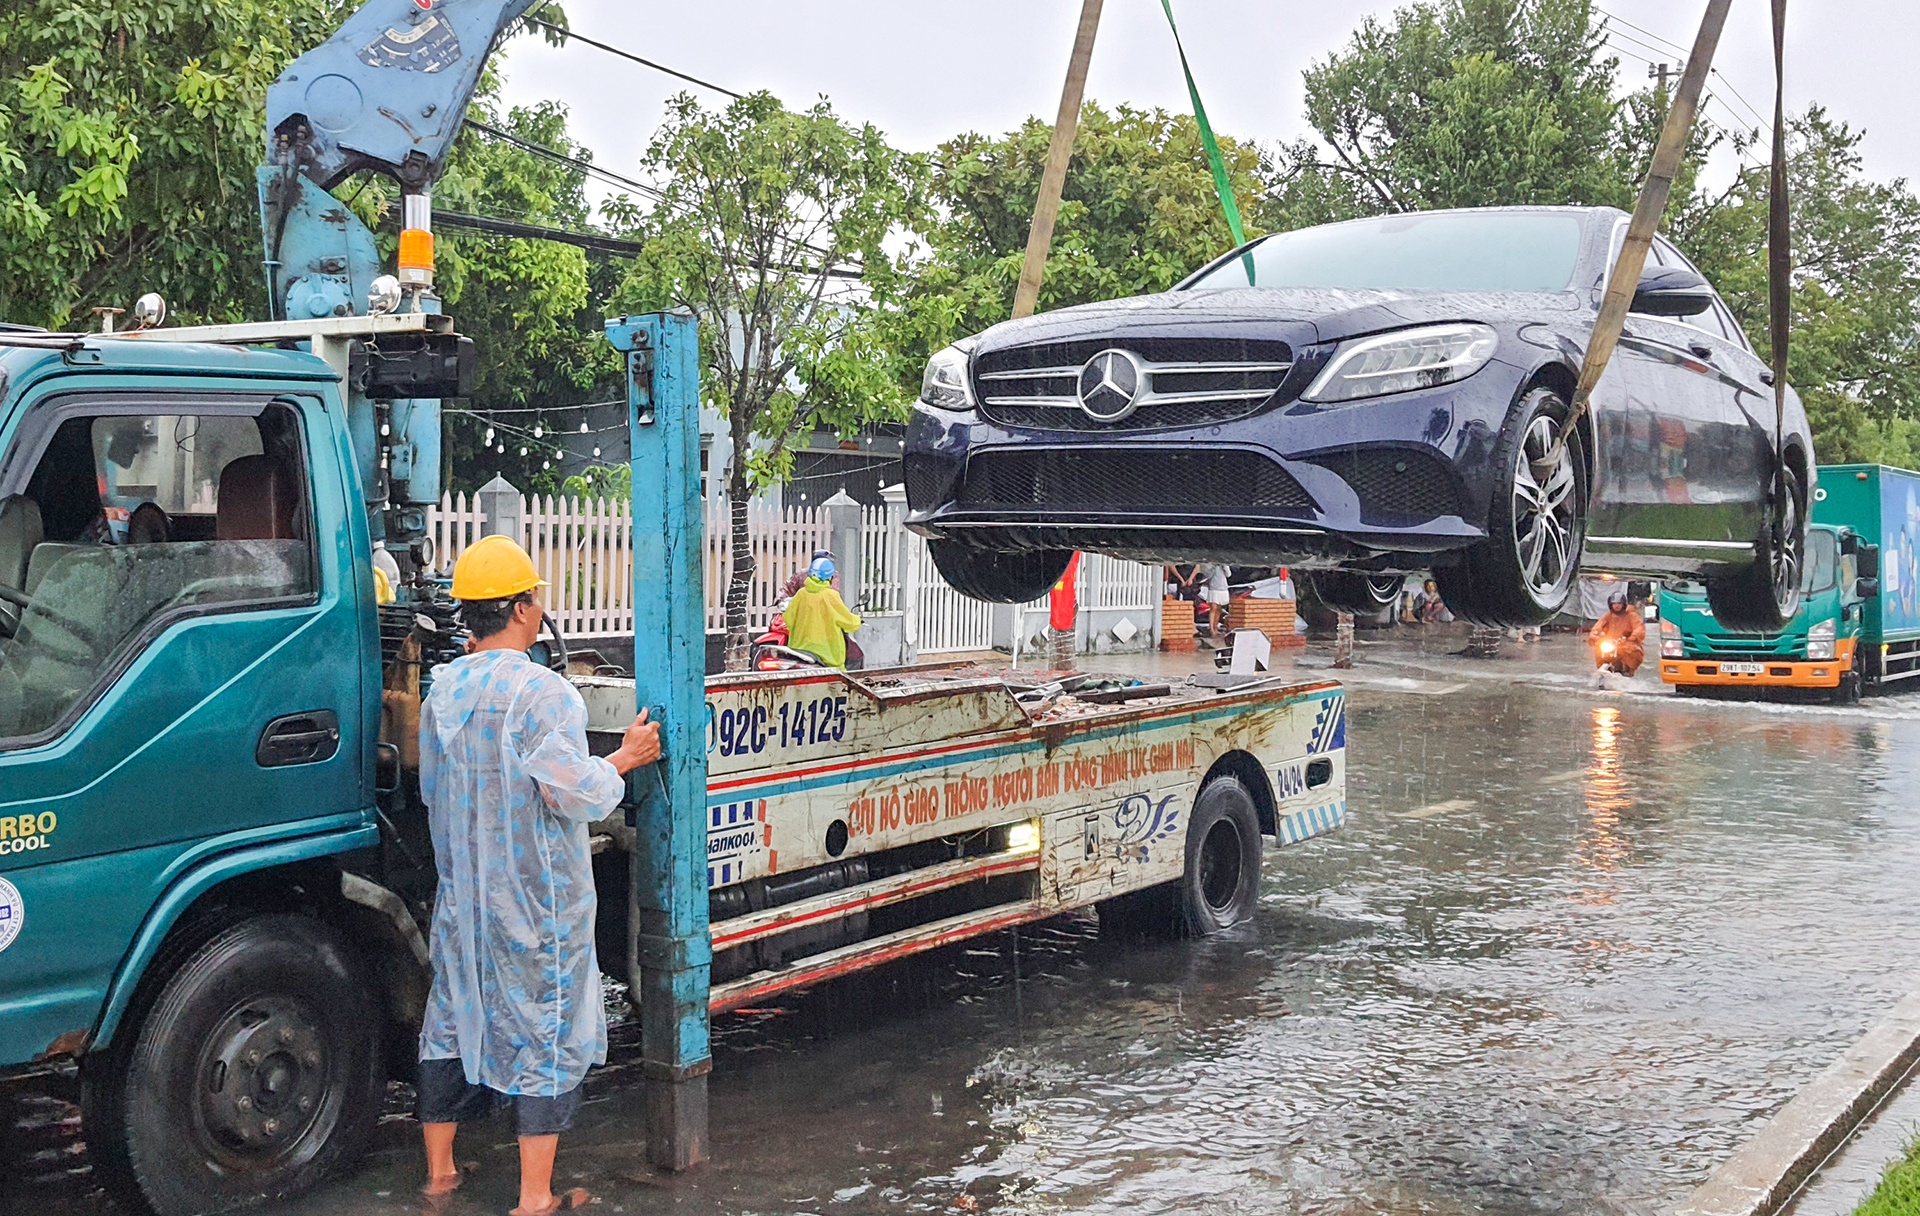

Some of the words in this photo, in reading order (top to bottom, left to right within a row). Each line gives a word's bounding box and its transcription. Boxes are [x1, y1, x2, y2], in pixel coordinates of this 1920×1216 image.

[719, 696, 847, 757] 92C-14125
[904, 785, 939, 825] GIAO
[944, 772, 988, 818] THÔNG
[1277, 764, 1304, 798] 24/24
